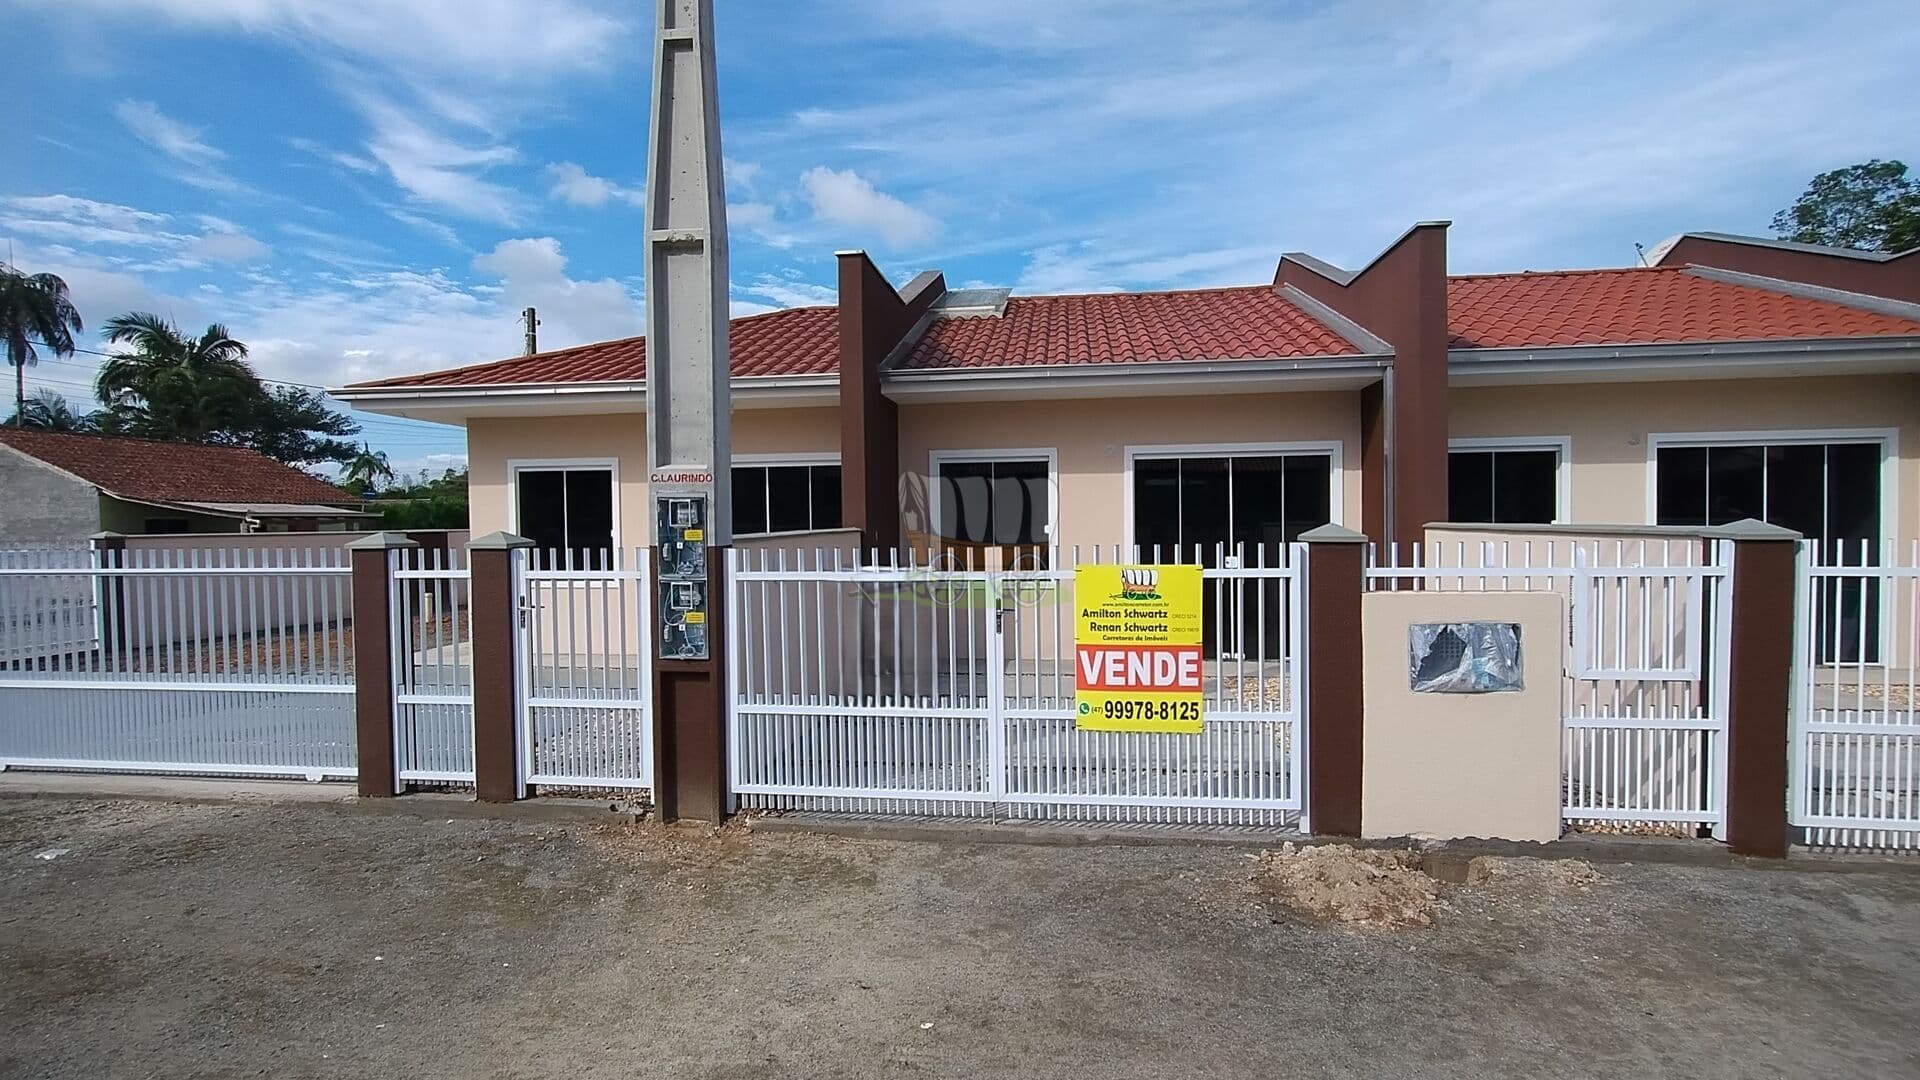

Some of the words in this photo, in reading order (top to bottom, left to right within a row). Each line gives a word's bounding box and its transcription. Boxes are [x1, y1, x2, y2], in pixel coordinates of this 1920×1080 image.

[1082, 608, 1121, 619] Amilton
[1124, 608, 1168, 619] Schwartz
[1090, 621, 1121, 632] Renan
[1124, 621, 1168, 633] Schwartz
[1079, 650, 1199, 687] VENDE
[1091, 706, 1103, 714] (47)
[1104, 700, 1199, 721] 99978-8125
